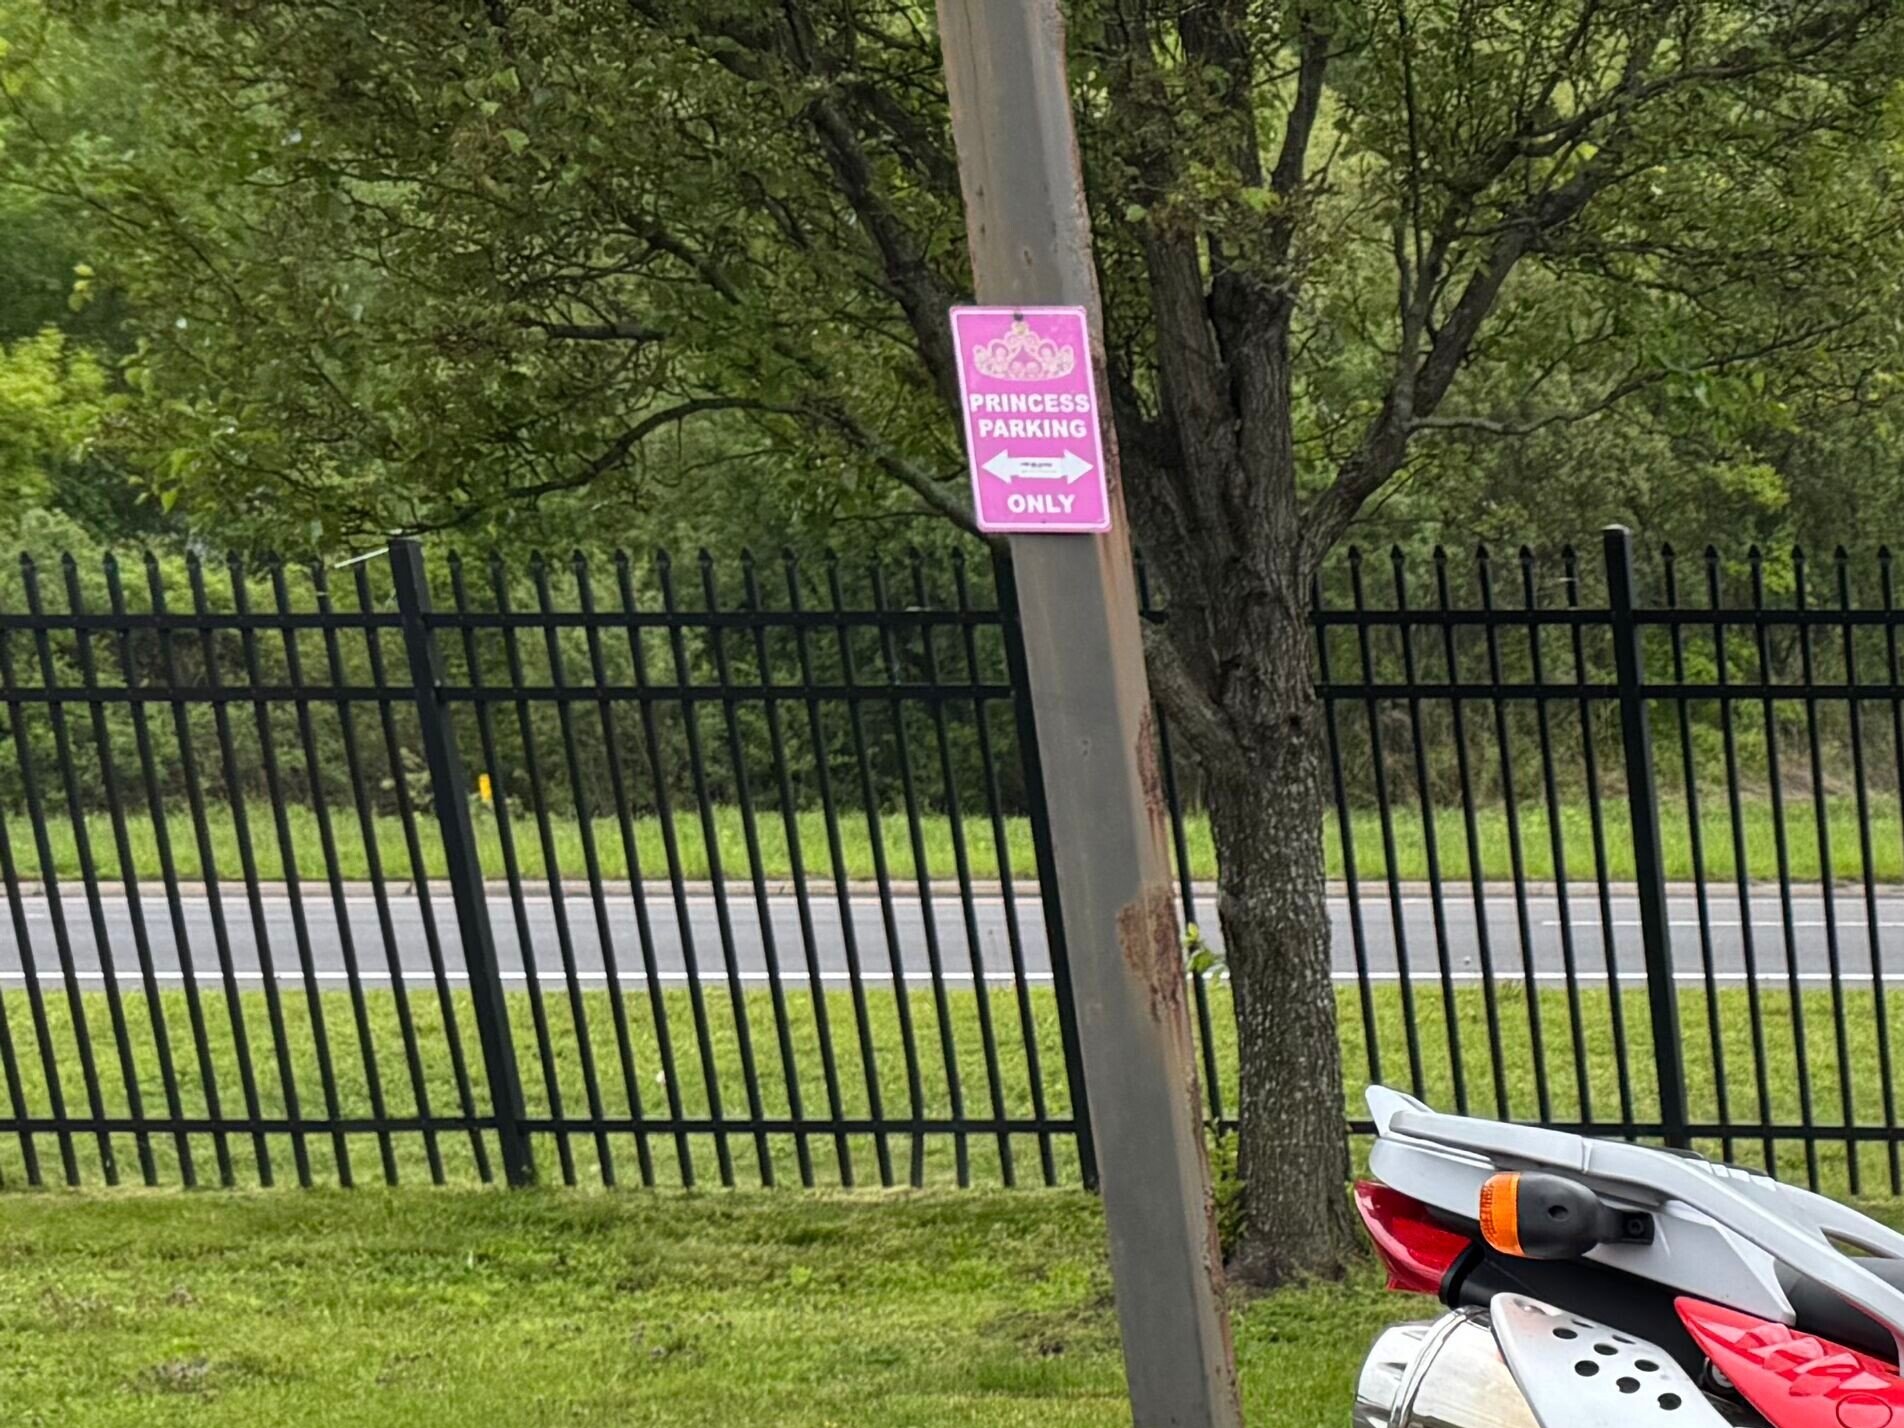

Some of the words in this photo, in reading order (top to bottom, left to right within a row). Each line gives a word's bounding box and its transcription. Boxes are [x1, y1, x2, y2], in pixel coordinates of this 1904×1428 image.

[970, 393, 1090, 413] PRINCESS
[978, 419, 1087, 438] PARKING
[1007, 494, 1075, 513] ONLY
